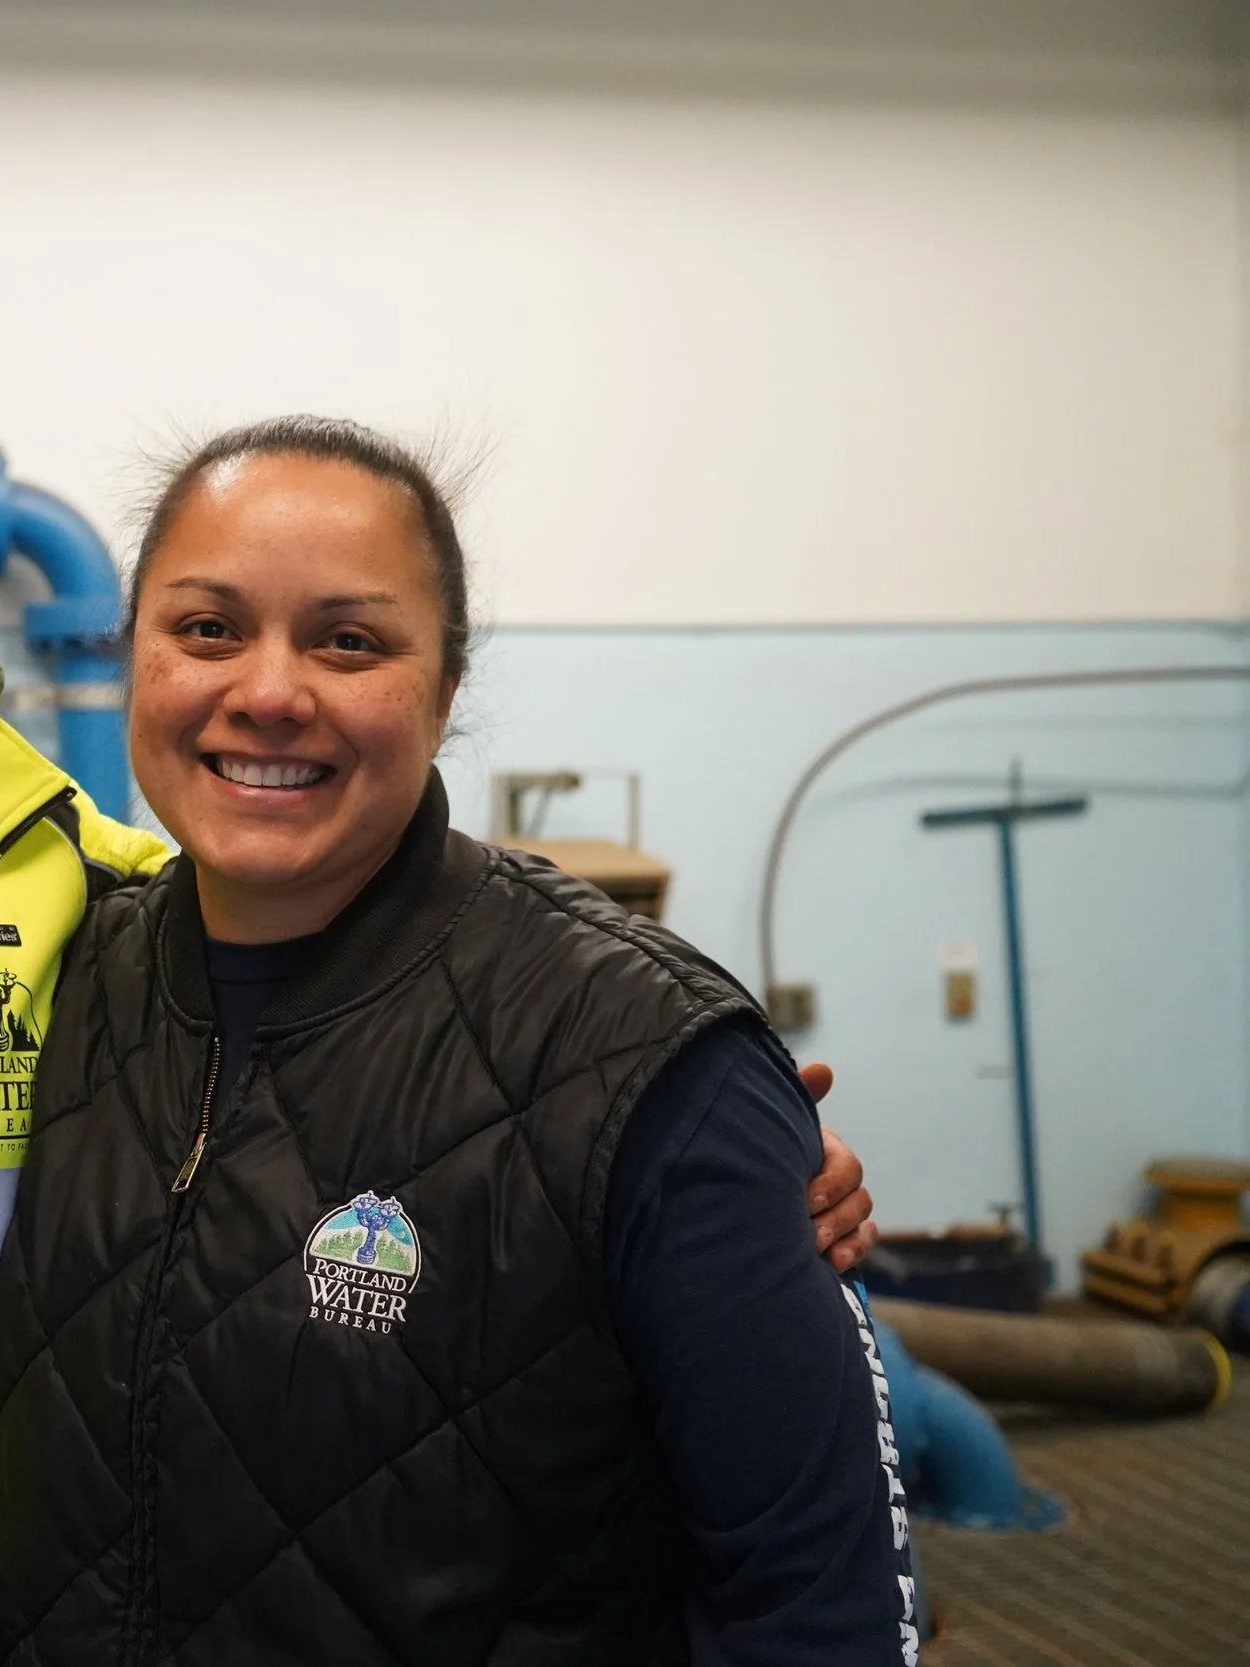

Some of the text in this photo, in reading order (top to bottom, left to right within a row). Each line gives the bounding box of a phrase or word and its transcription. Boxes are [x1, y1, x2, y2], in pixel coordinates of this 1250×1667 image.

[7, 1143, 15, 1151] TO
[313, 1257, 407, 1292] PORTLAND
[305, 1273, 407, 1323] WATER
[308, 1306, 392, 1334] BUREAU
